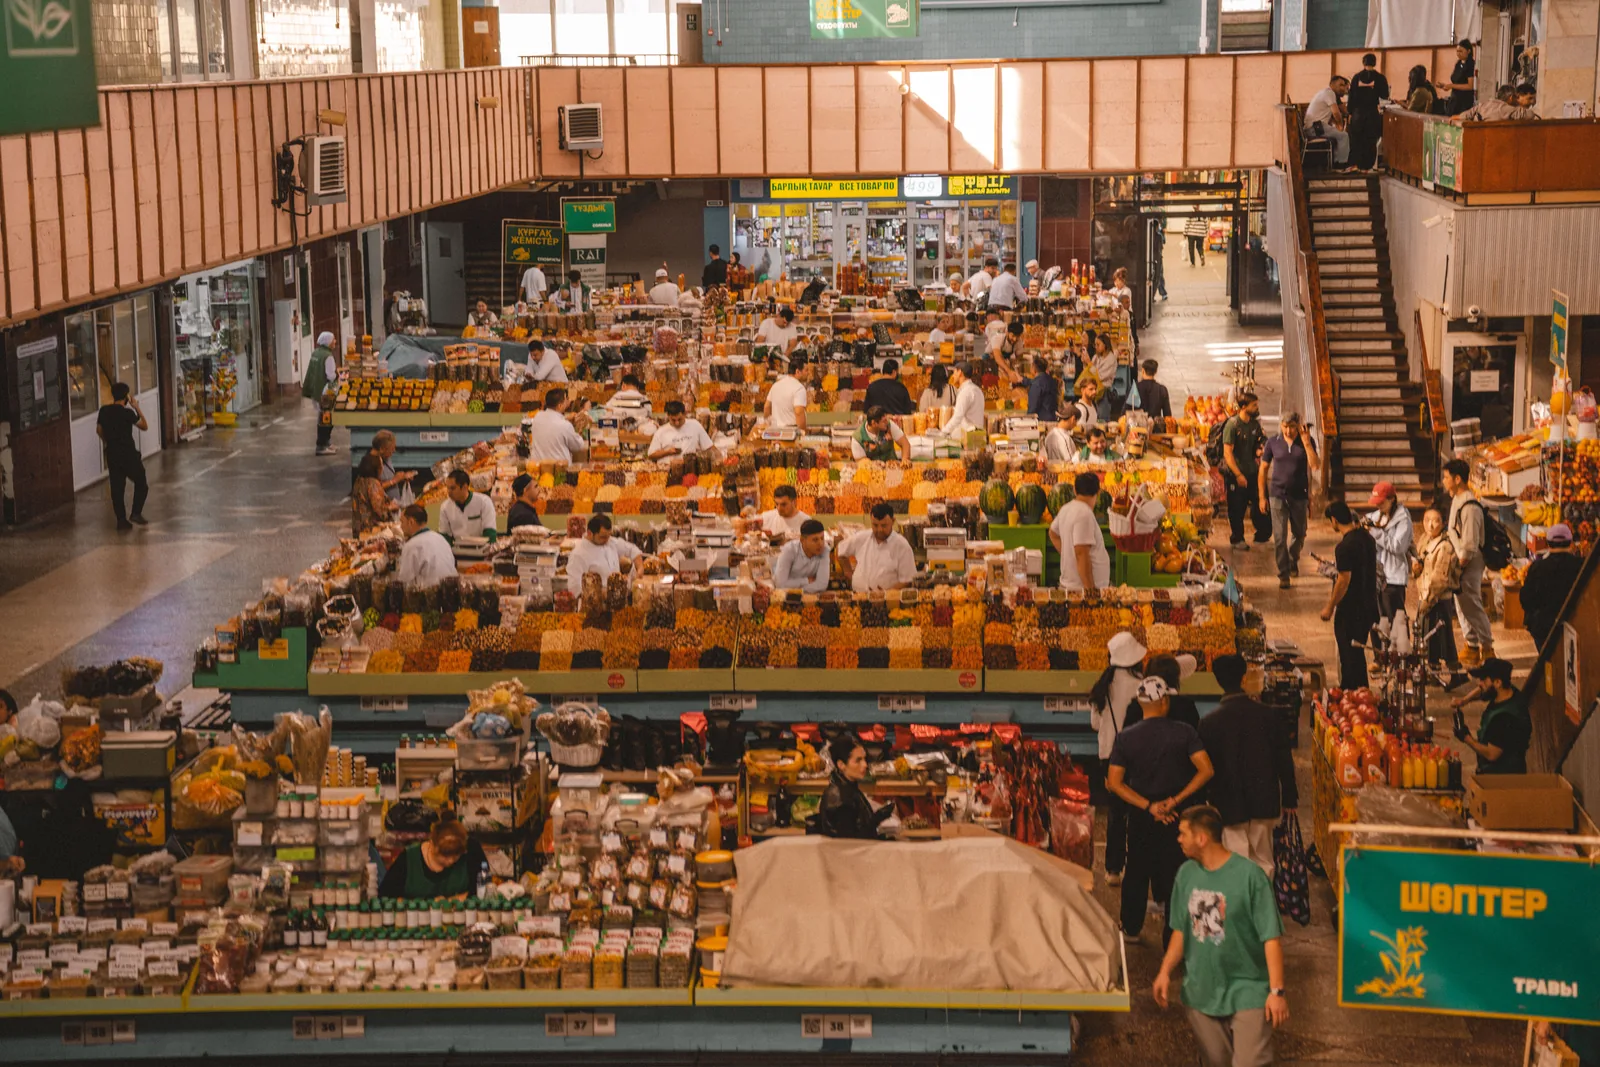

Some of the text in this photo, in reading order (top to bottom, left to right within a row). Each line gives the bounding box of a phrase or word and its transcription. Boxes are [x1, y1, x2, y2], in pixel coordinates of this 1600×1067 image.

[809, 182, 833, 191] ТАУАР
[839, 182, 854, 191] ВСЕ
[856, 182, 882, 190] ТОВАР
[883, 181, 895, 190] ПО
[511, 236, 559, 246] ЖЕМІСТЕР
[576, 249, 600, 260] RAI
[1400, 880, 1548, 919] ШӨПТЕР
[1512, 976, 1578, 998] ТРАВЫ
[573, 1019, 587, 1030] 37
